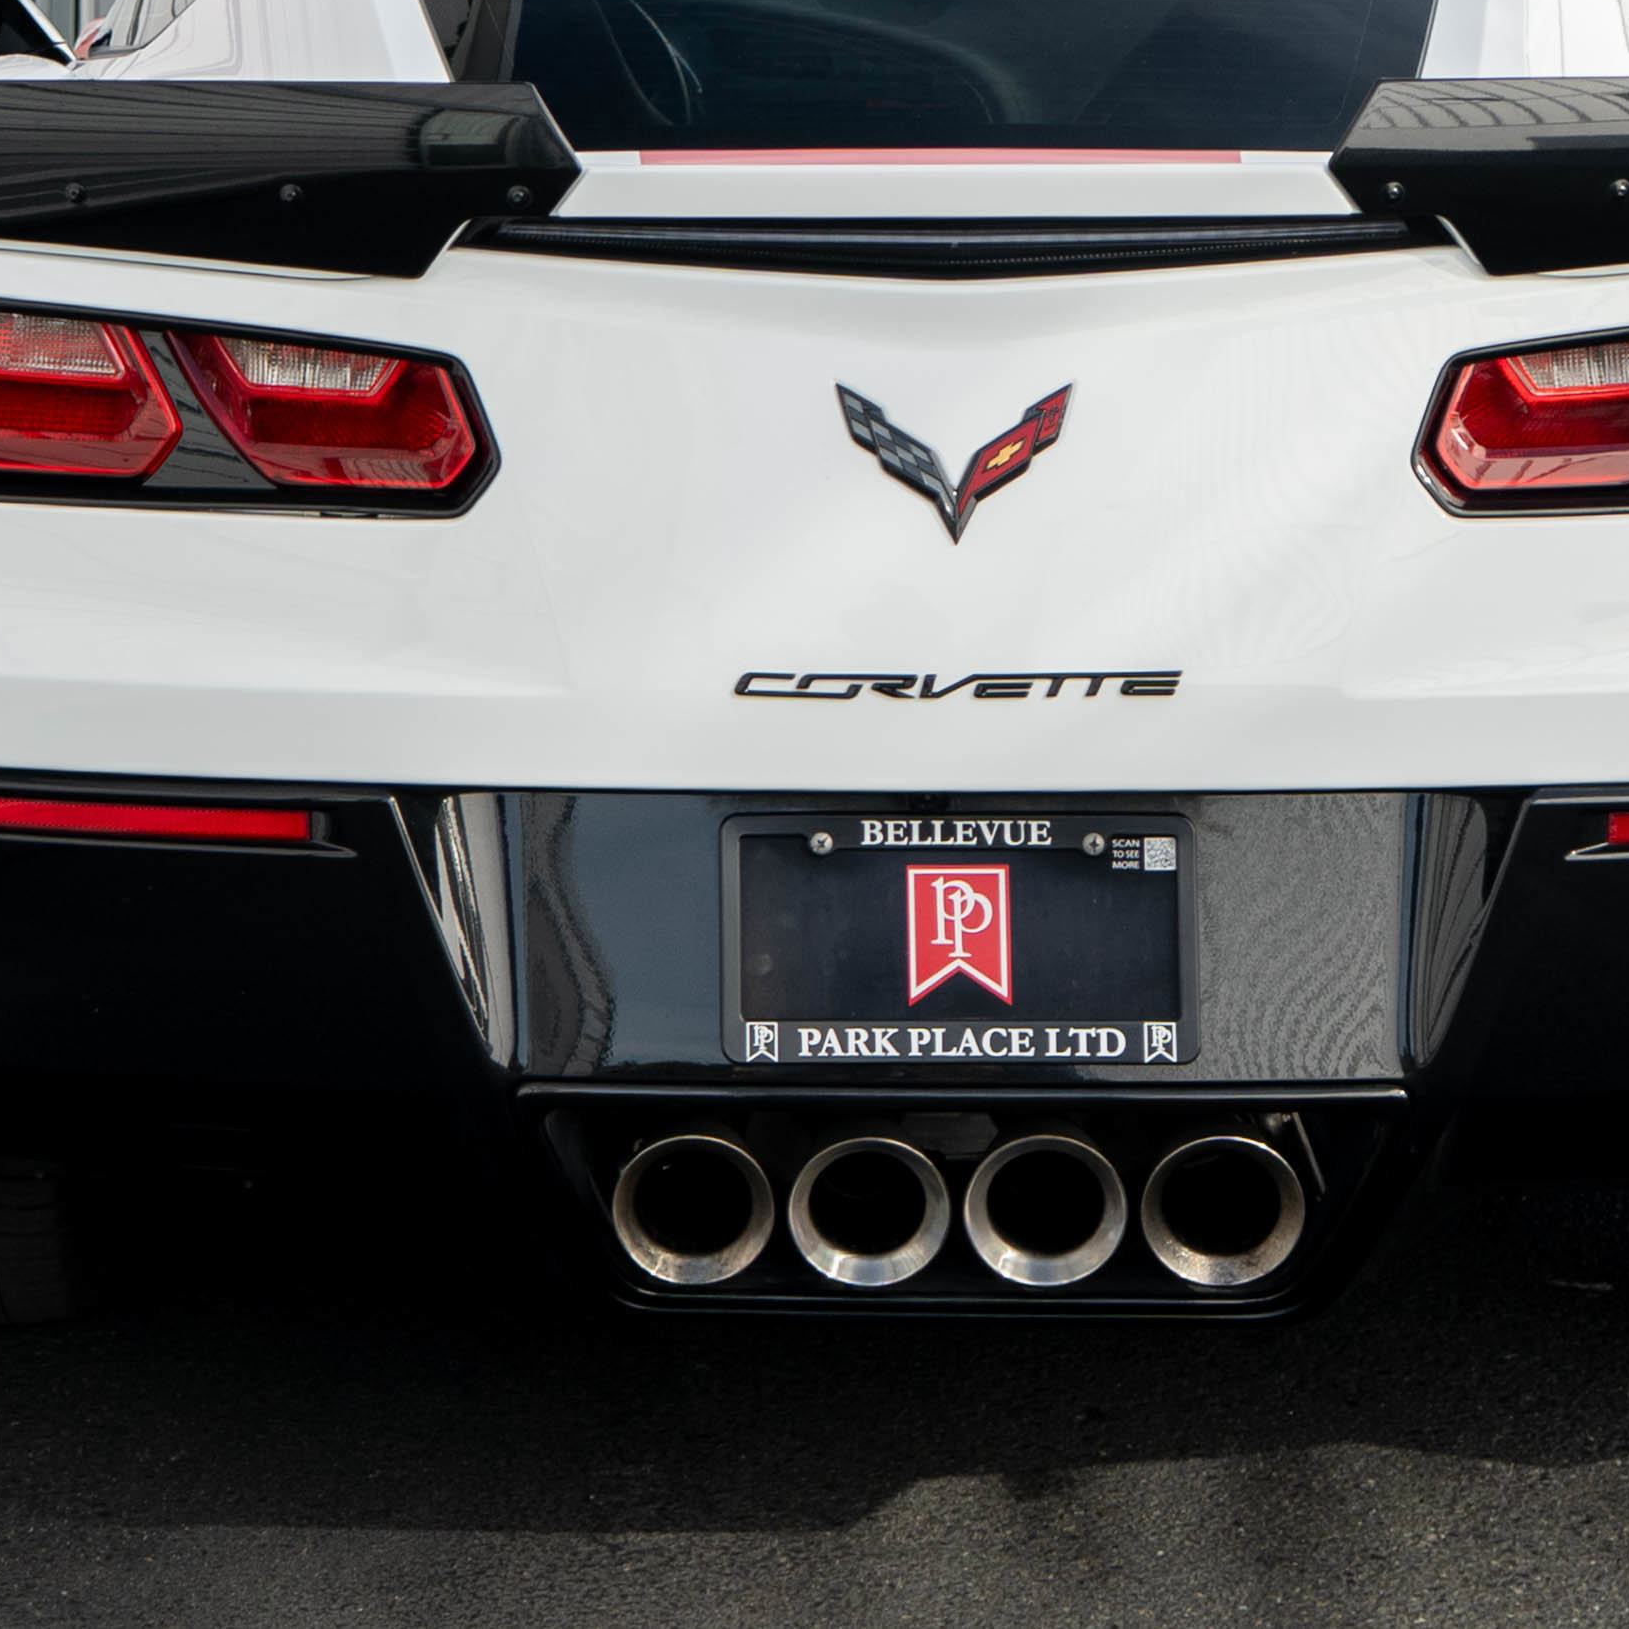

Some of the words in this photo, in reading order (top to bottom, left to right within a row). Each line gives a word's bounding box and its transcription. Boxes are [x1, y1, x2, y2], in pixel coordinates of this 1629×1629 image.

[733, 669, 1184, 700] CORVETTE
[860, 819, 1053, 846] BELLEVUE
[1112, 838, 1141, 849] SCAN
[1113, 849, 1125, 860] TO
[1112, 859, 1140, 870] MORE
[796, 1027, 901, 1057] PARK
[907, 1027, 1036, 1057] PLACE
[1044, 1027, 1127, 1057] LTD
